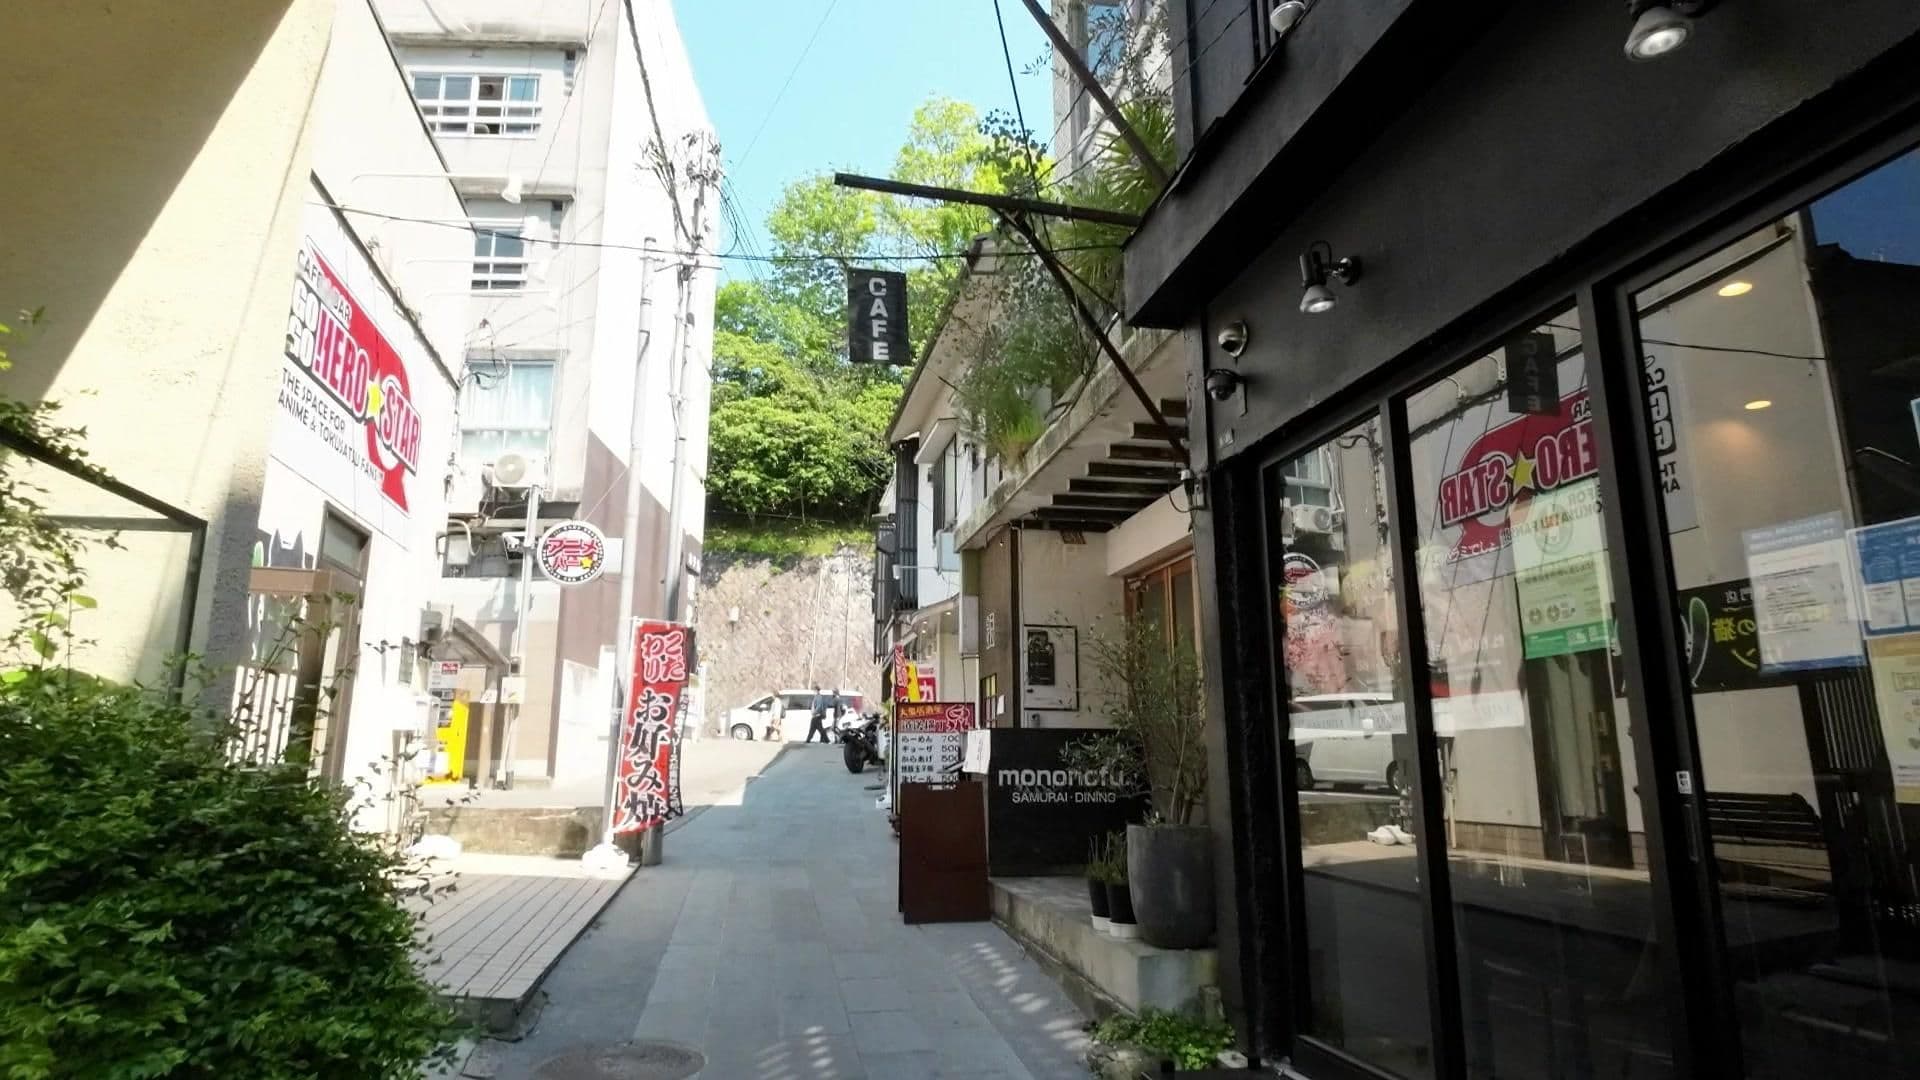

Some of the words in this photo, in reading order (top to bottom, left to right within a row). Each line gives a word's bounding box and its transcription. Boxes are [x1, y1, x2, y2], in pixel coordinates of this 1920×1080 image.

[868, 277, 890, 361] CAFE
[278, 389, 309, 427] ANIME
[310, 415, 317, 431] &
[283, 367, 300, 397] THE
[302, 384, 328, 420] SPACE
[329, 411, 346, 433] FOR
[312, 304, 370, 419] HERO
[381, 375, 422, 474] STAR
[546, 538, 599, 557] アニメ
